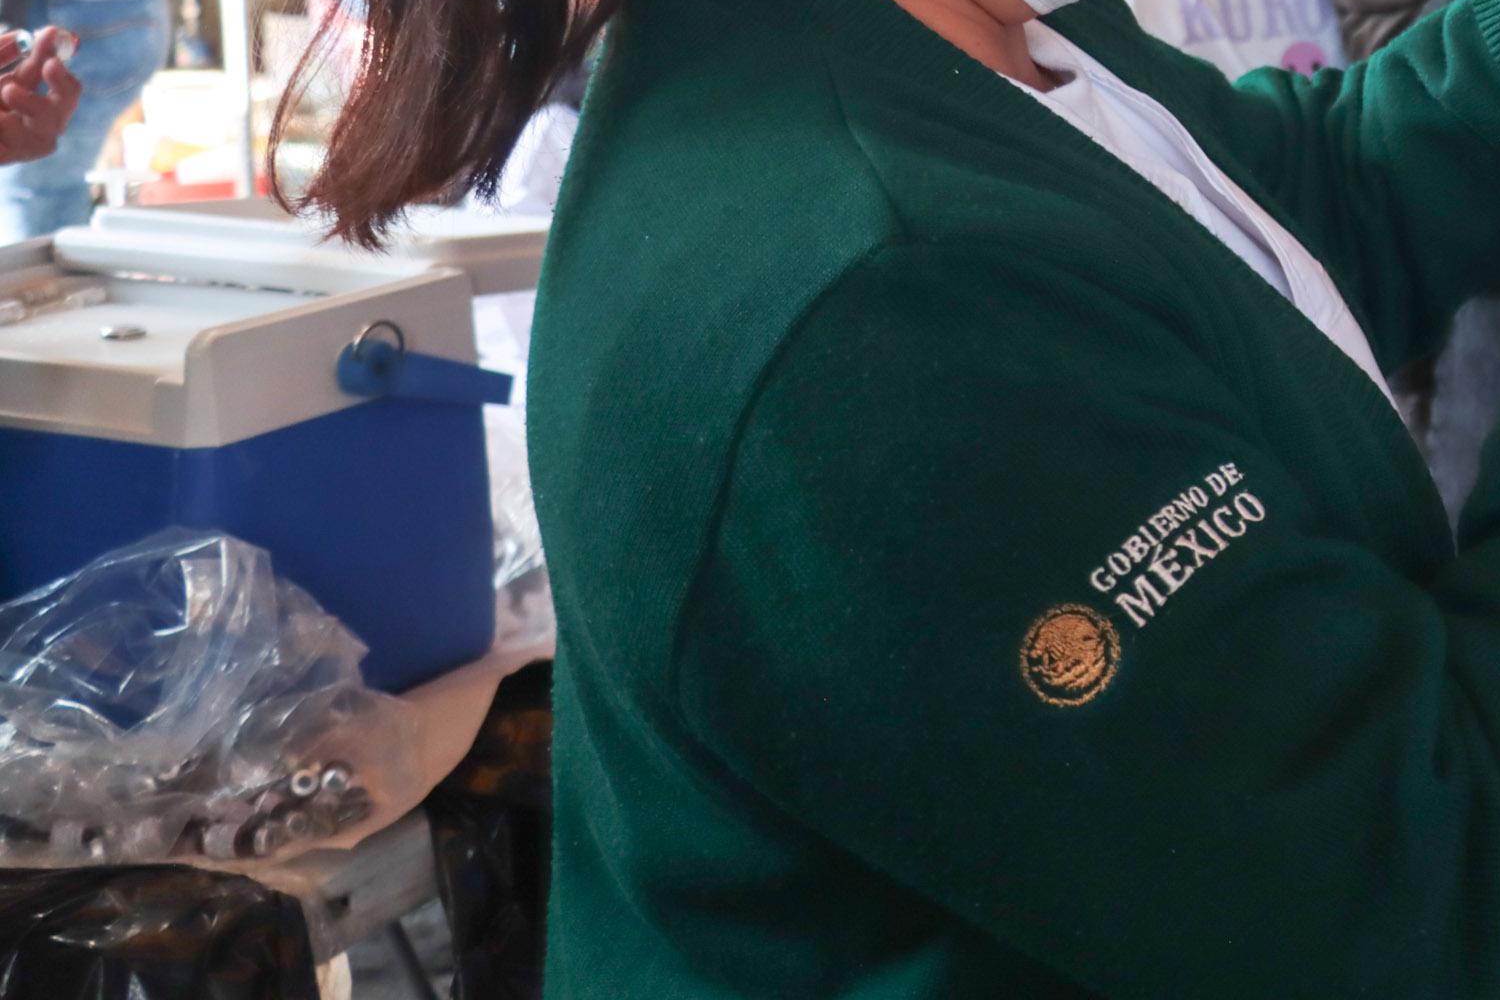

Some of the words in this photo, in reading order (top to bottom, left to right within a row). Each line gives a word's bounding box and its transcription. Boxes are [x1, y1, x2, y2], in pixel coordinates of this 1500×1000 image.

[1090, 486, 1209, 593] GOBIERNO
[1205, 462, 1245, 497] DE
[1115, 492, 1266, 628] MÉXICO
